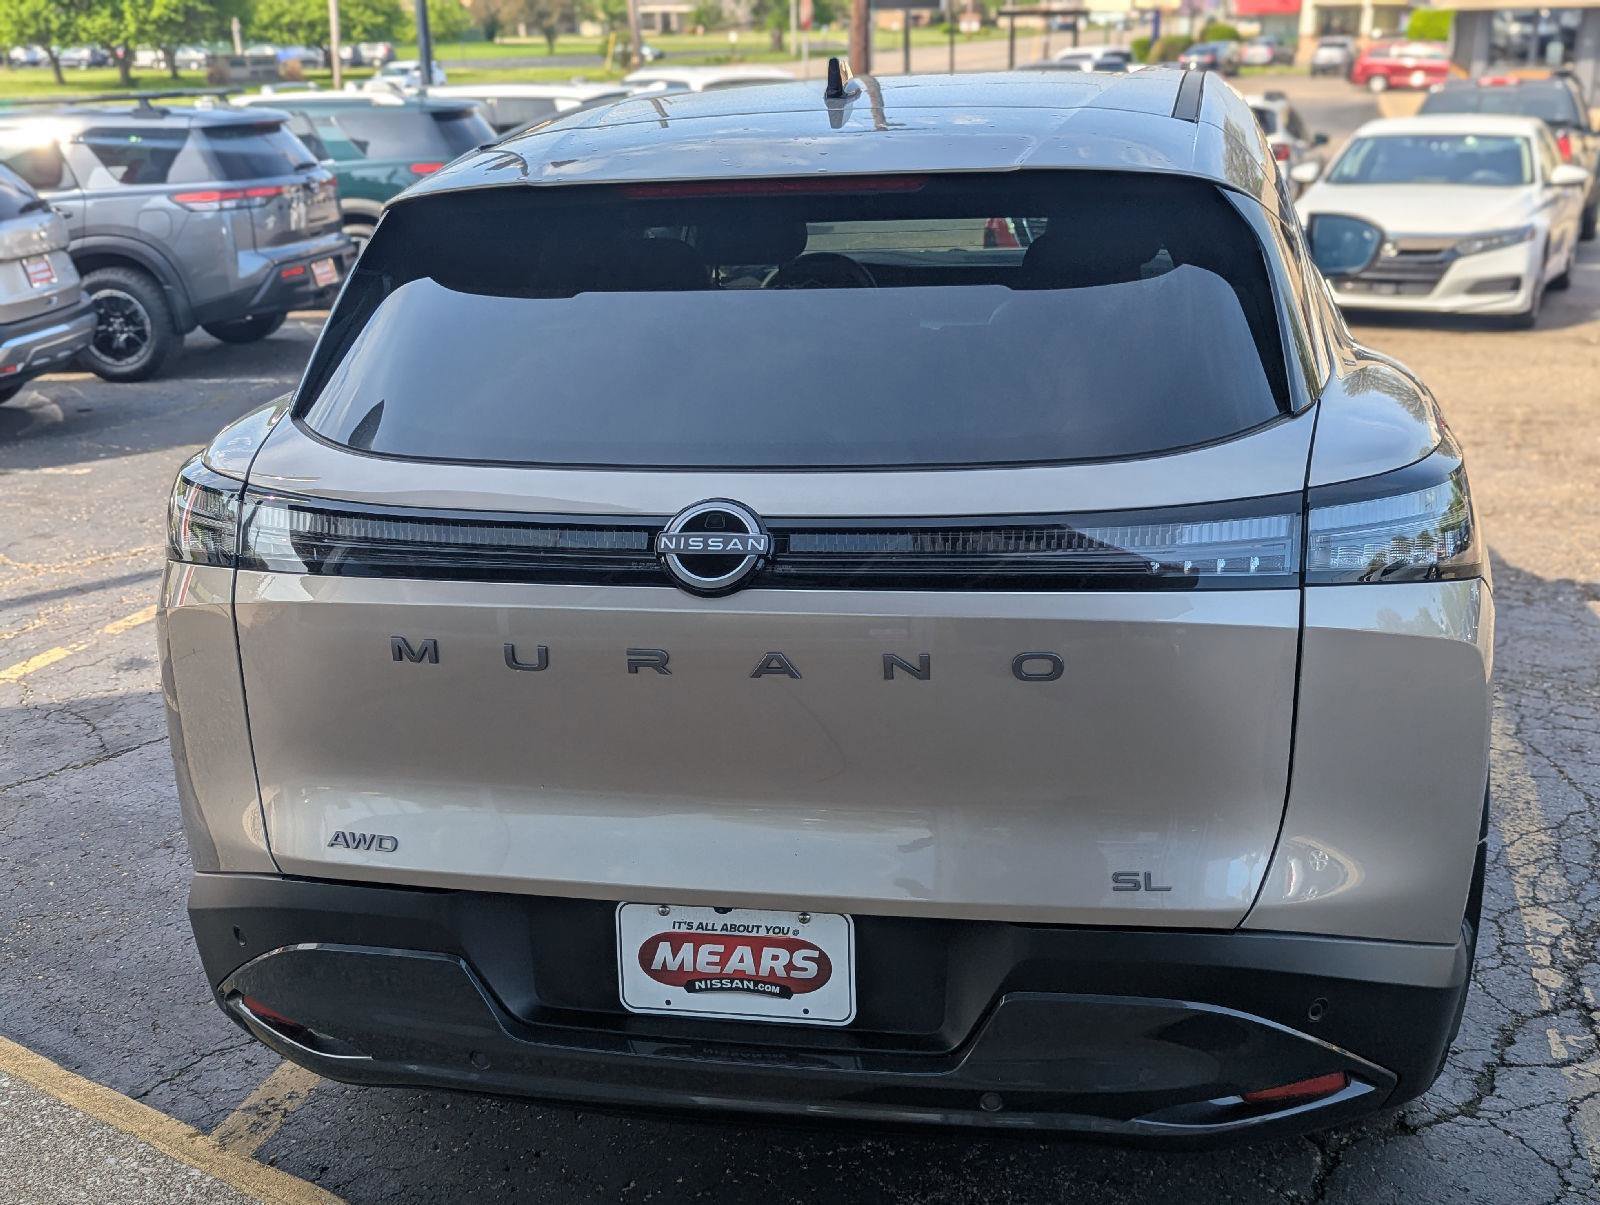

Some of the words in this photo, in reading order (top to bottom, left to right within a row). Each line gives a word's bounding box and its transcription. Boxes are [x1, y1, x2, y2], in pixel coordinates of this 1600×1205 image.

[660, 537, 765, 551] NISSAN
[390, 635, 1065, 682] MURANO
[327, 830, 399, 853] AWD
[1112, 871, 1172, 892] SL
[672, 920, 694, 931] IT'S
[695, 921, 718, 932] ALL
[720, 923, 762, 934] ABOUT
[764, 925, 790, 936] YOU
[650, 941, 820, 979] MEARS
